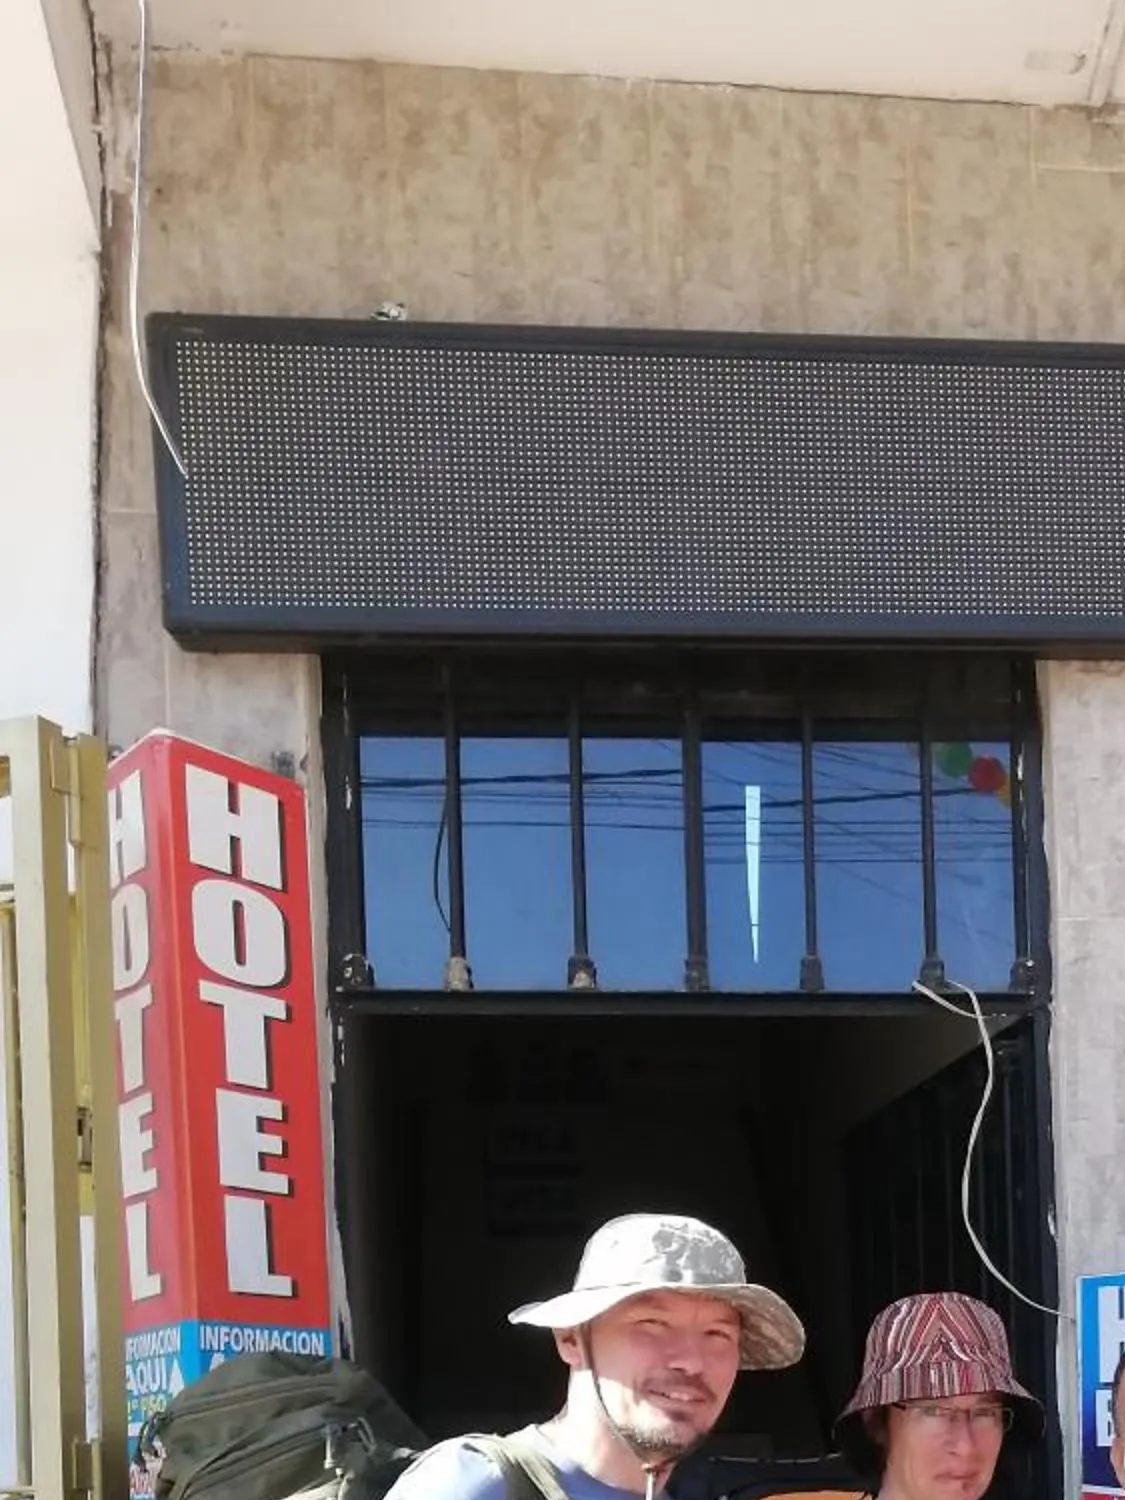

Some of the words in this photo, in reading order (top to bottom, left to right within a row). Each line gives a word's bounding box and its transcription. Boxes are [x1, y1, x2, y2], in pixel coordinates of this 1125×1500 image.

[108, 768, 163, 1303] HOTEL
[185, 762, 296, 1298] HOTEL
[200, 1326, 325, 1357] INFORMACION
